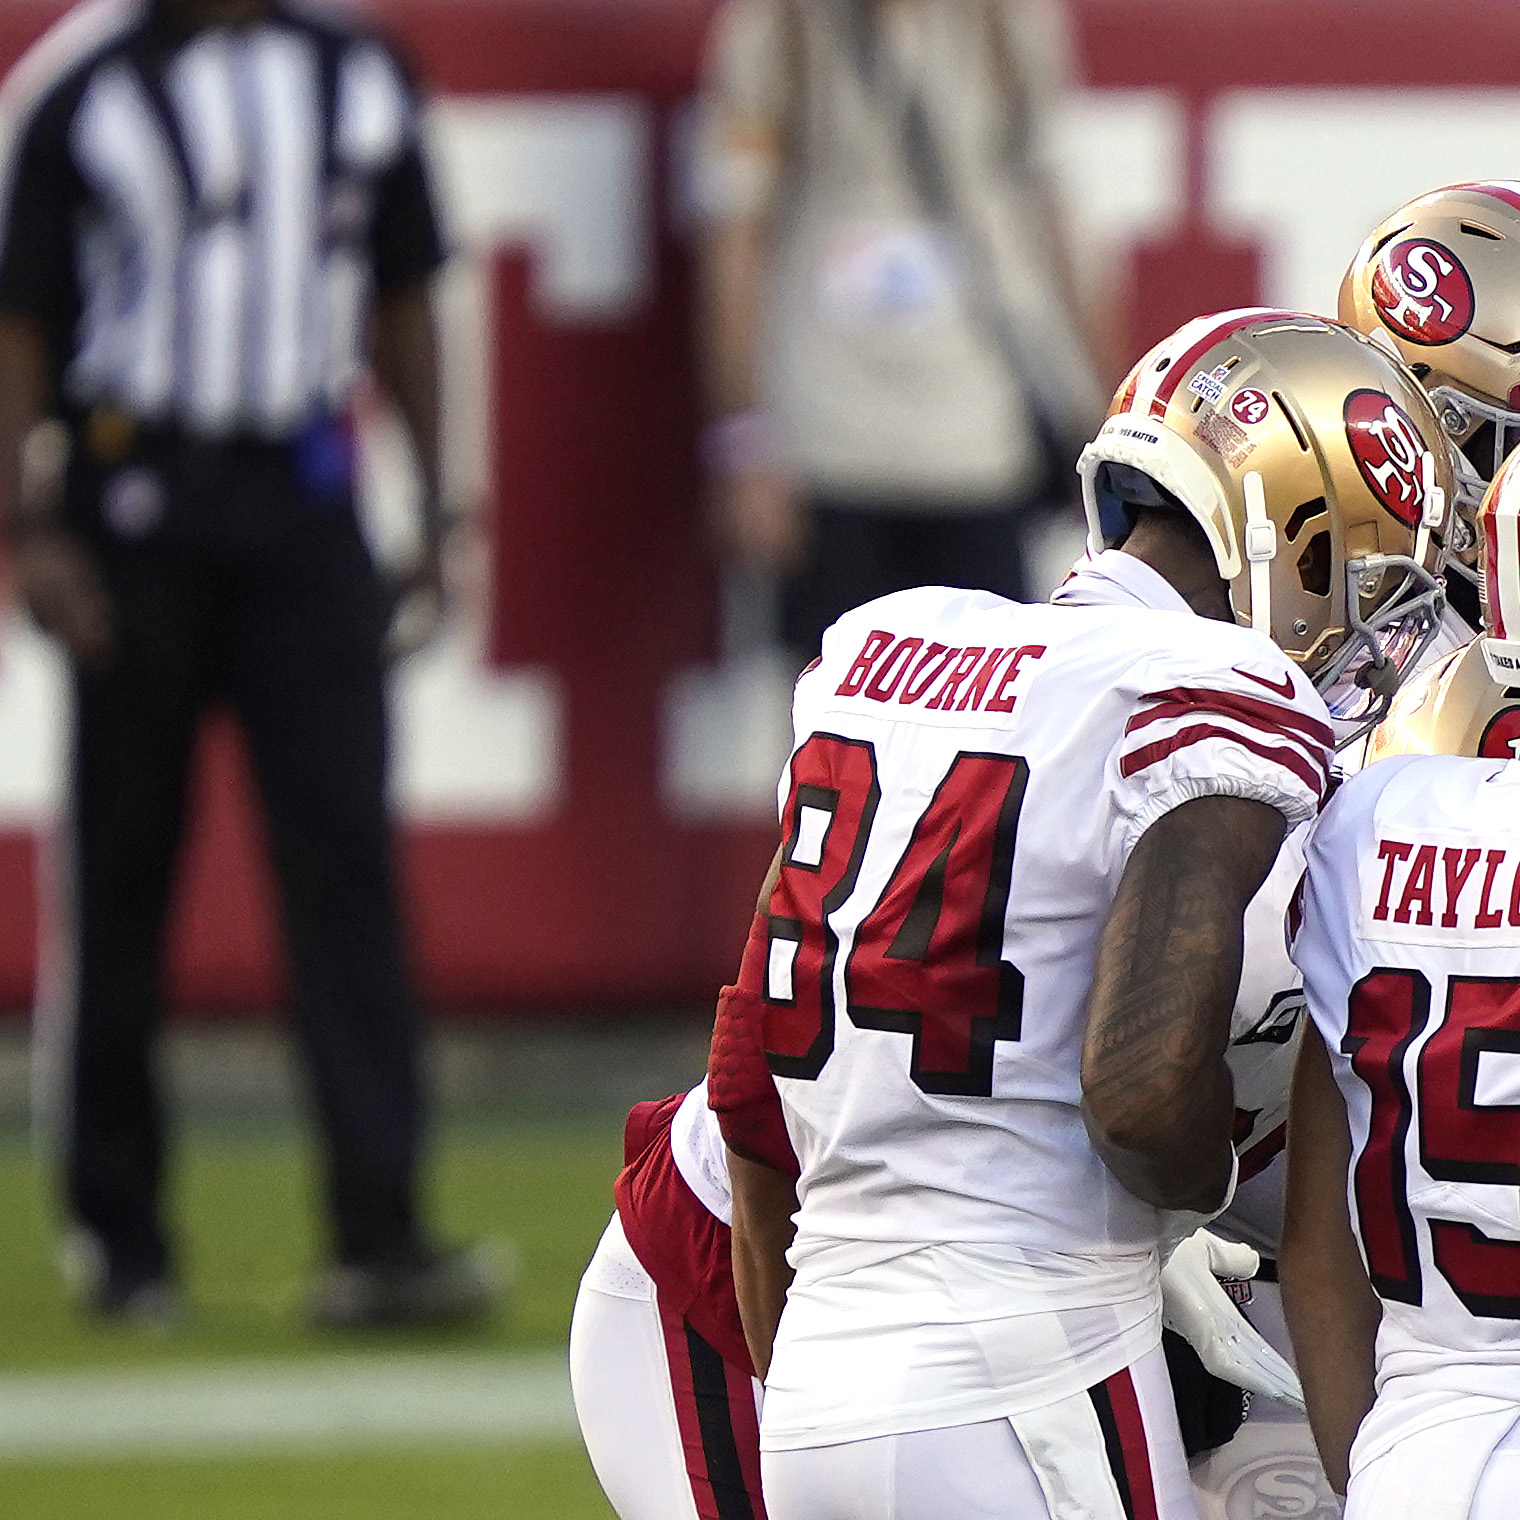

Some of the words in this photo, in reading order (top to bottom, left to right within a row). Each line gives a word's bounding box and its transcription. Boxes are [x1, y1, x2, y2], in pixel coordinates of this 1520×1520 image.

[1191, 379, 1220, 400] CATCH
[1233, 390, 1268, 422] 74
[834, 629, 1047, 714] BOURNE
[762, 730, 1031, 1098] 84
